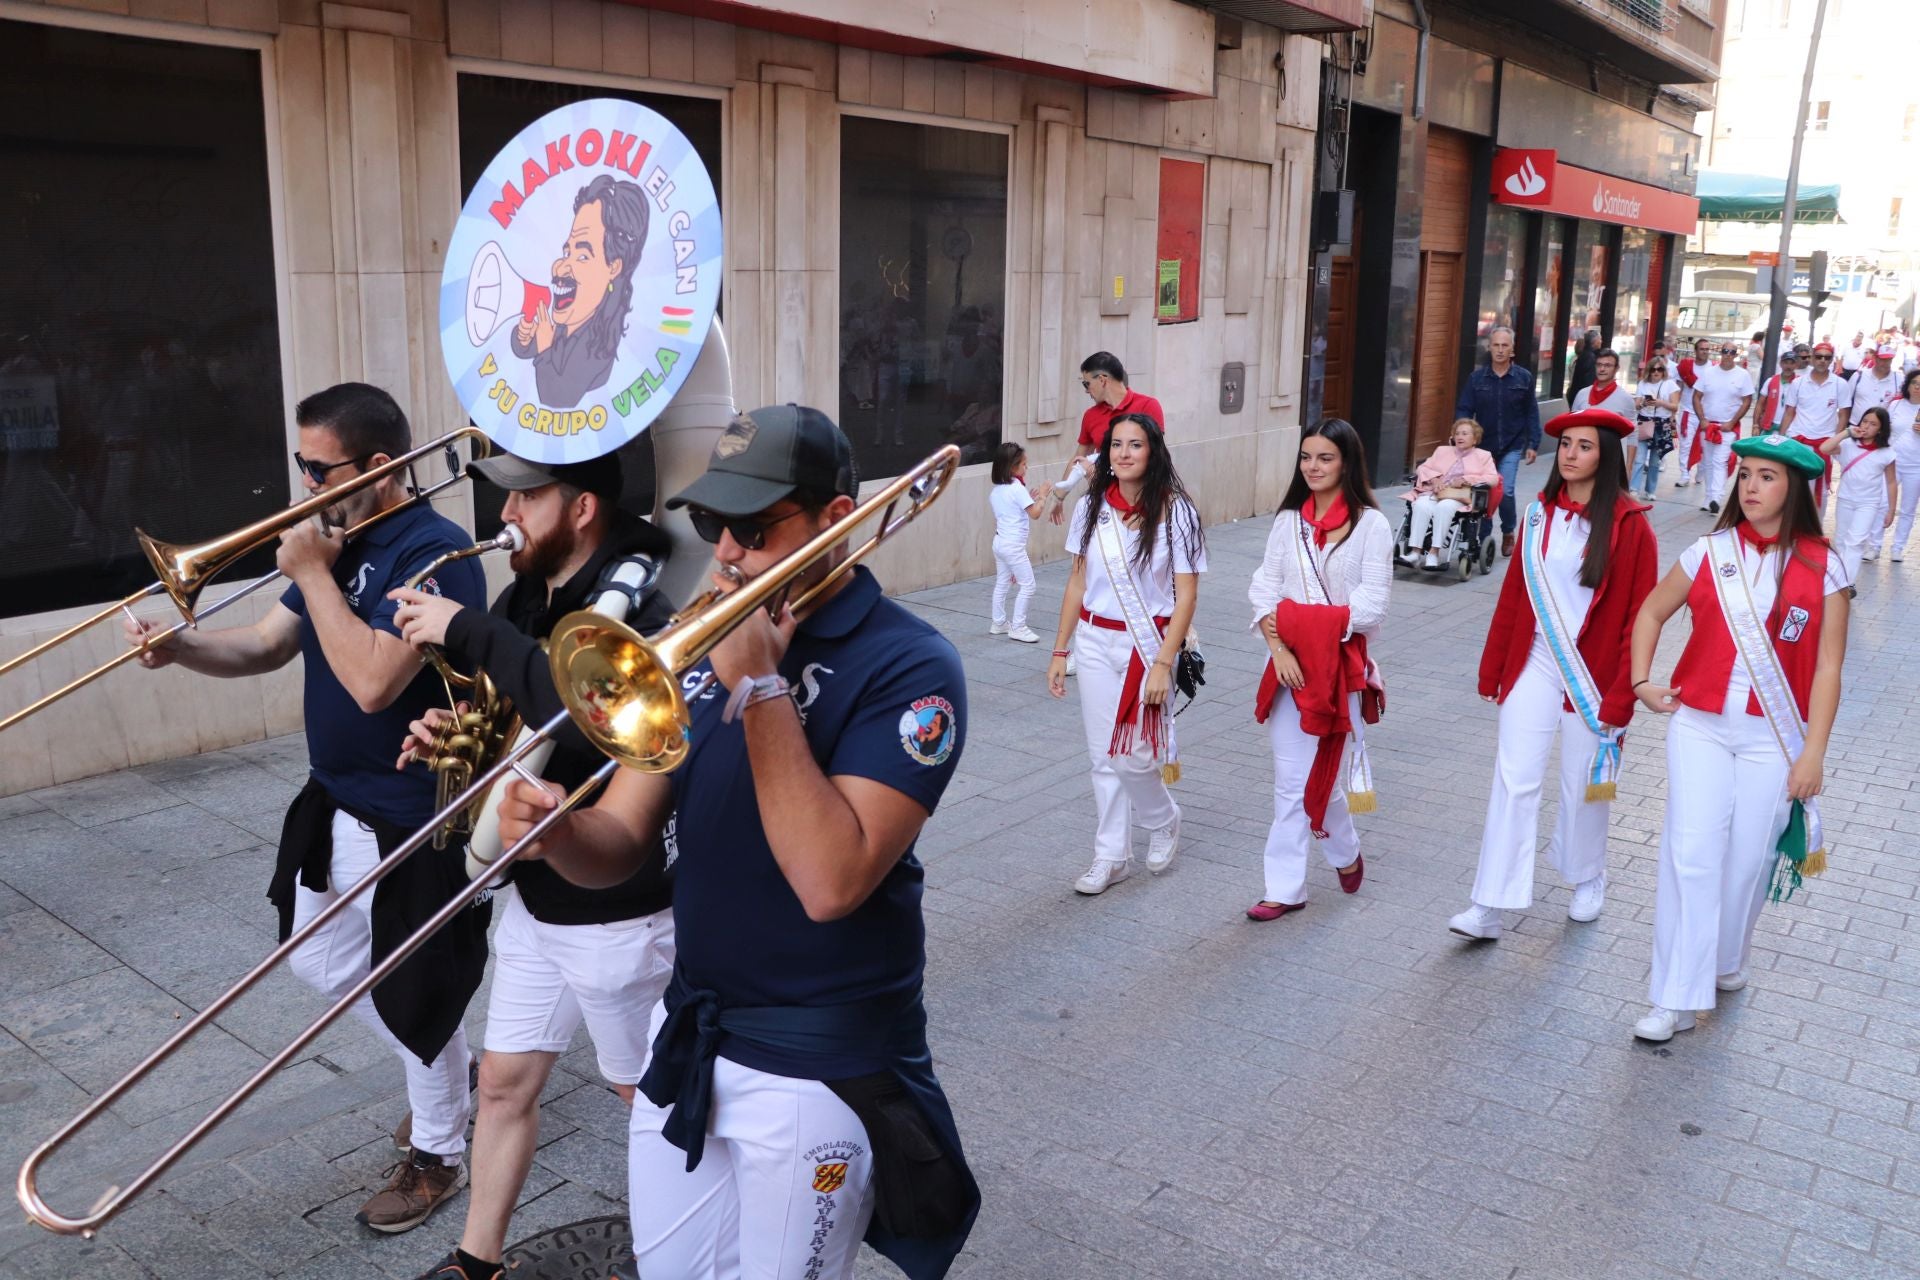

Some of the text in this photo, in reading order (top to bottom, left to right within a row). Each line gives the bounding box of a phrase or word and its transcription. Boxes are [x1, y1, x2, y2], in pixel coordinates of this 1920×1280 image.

[488, 128, 697, 295] MAKOKI EL CAN
[1603, 190, 1641, 219] Santander
[478, 347, 681, 436] Y SU GRUPO VELA
[911, 696, 954, 714] MAKOKI
[803, 1140, 864, 1161] EMBOLADORES
